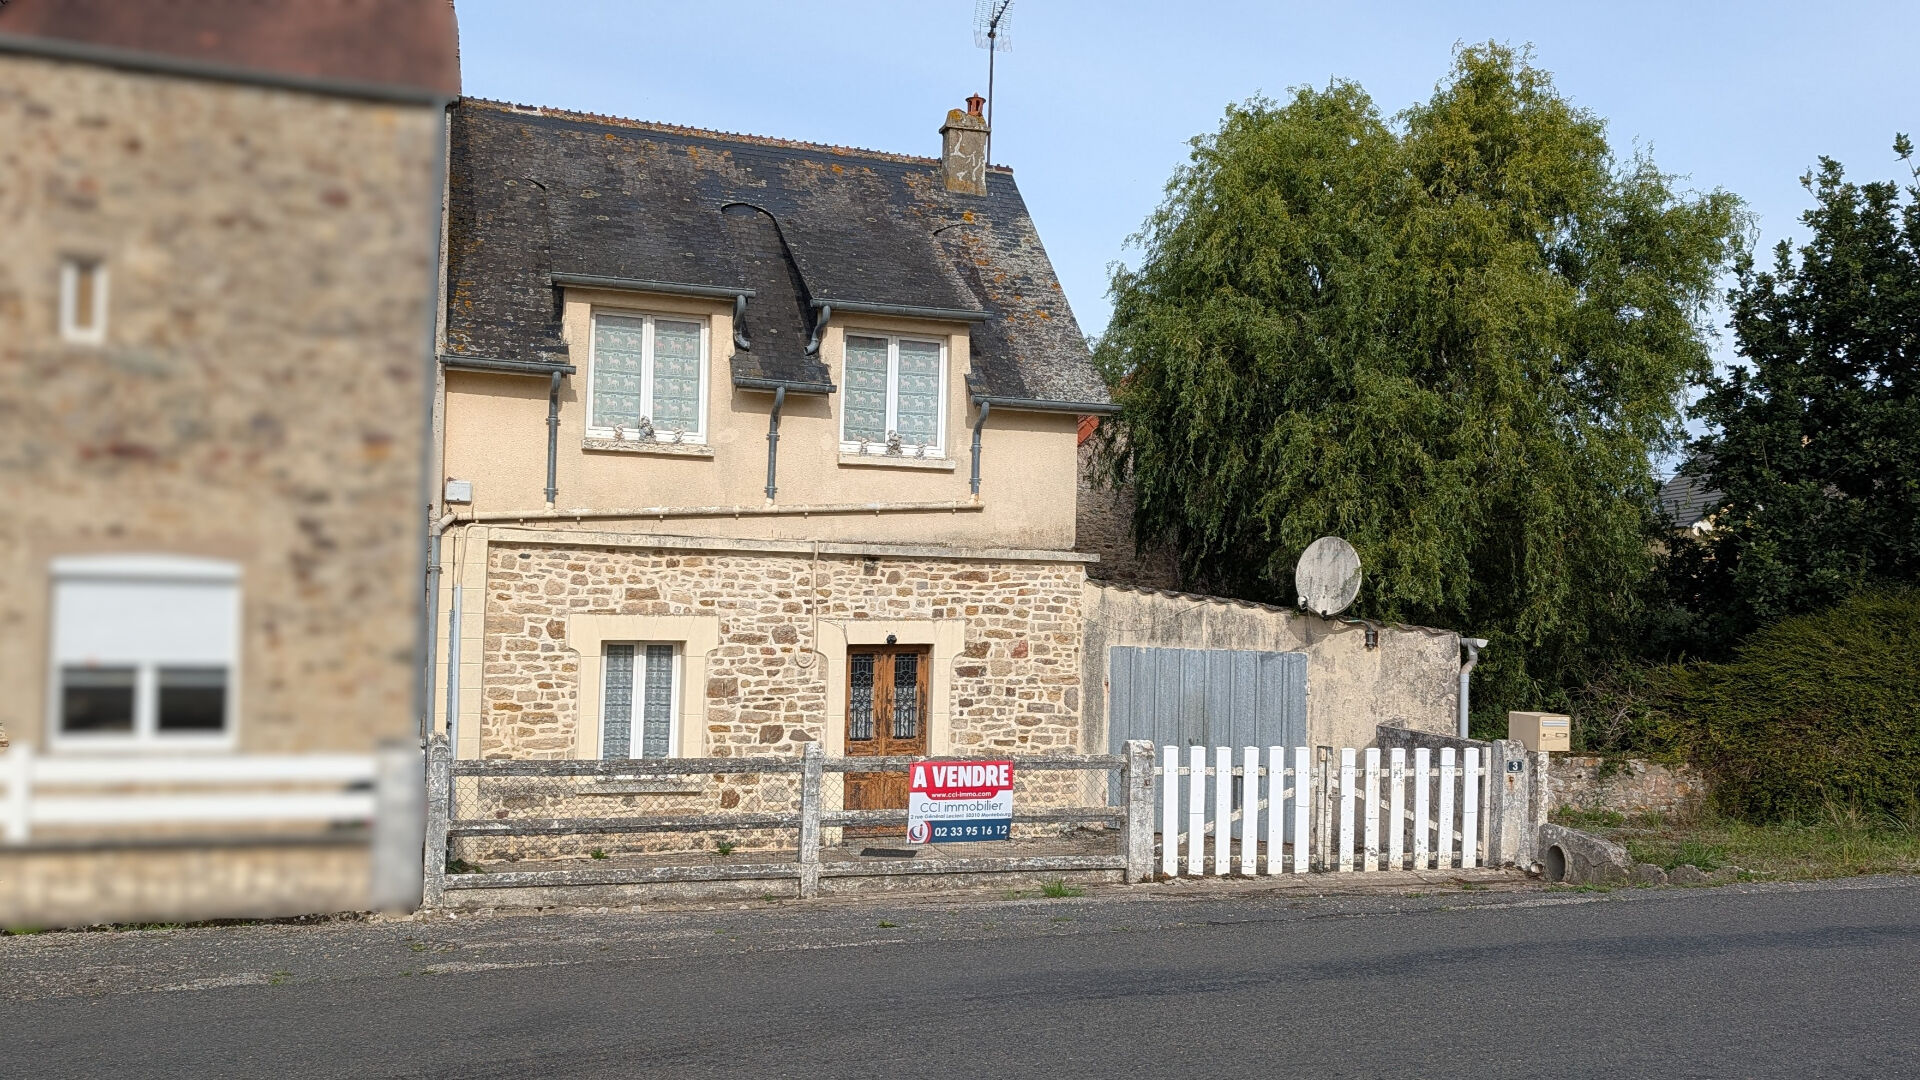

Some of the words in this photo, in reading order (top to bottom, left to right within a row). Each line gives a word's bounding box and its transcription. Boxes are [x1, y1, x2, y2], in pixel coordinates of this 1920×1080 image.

[1512, 761, 1518, 770] 3
[913, 766, 927, 788] A
[932, 765, 1009, 787] VENDRE
[920, 802, 940, 813] CCI
[944, 800, 1003, 812] immobilier
[934, 826, 948, 837] 02
[950, 826, 963, 836] 33
[965, 826, 978, 836] 95
[981, 825, 993, 835] 16
[996, 825, 1008, 834] 12
